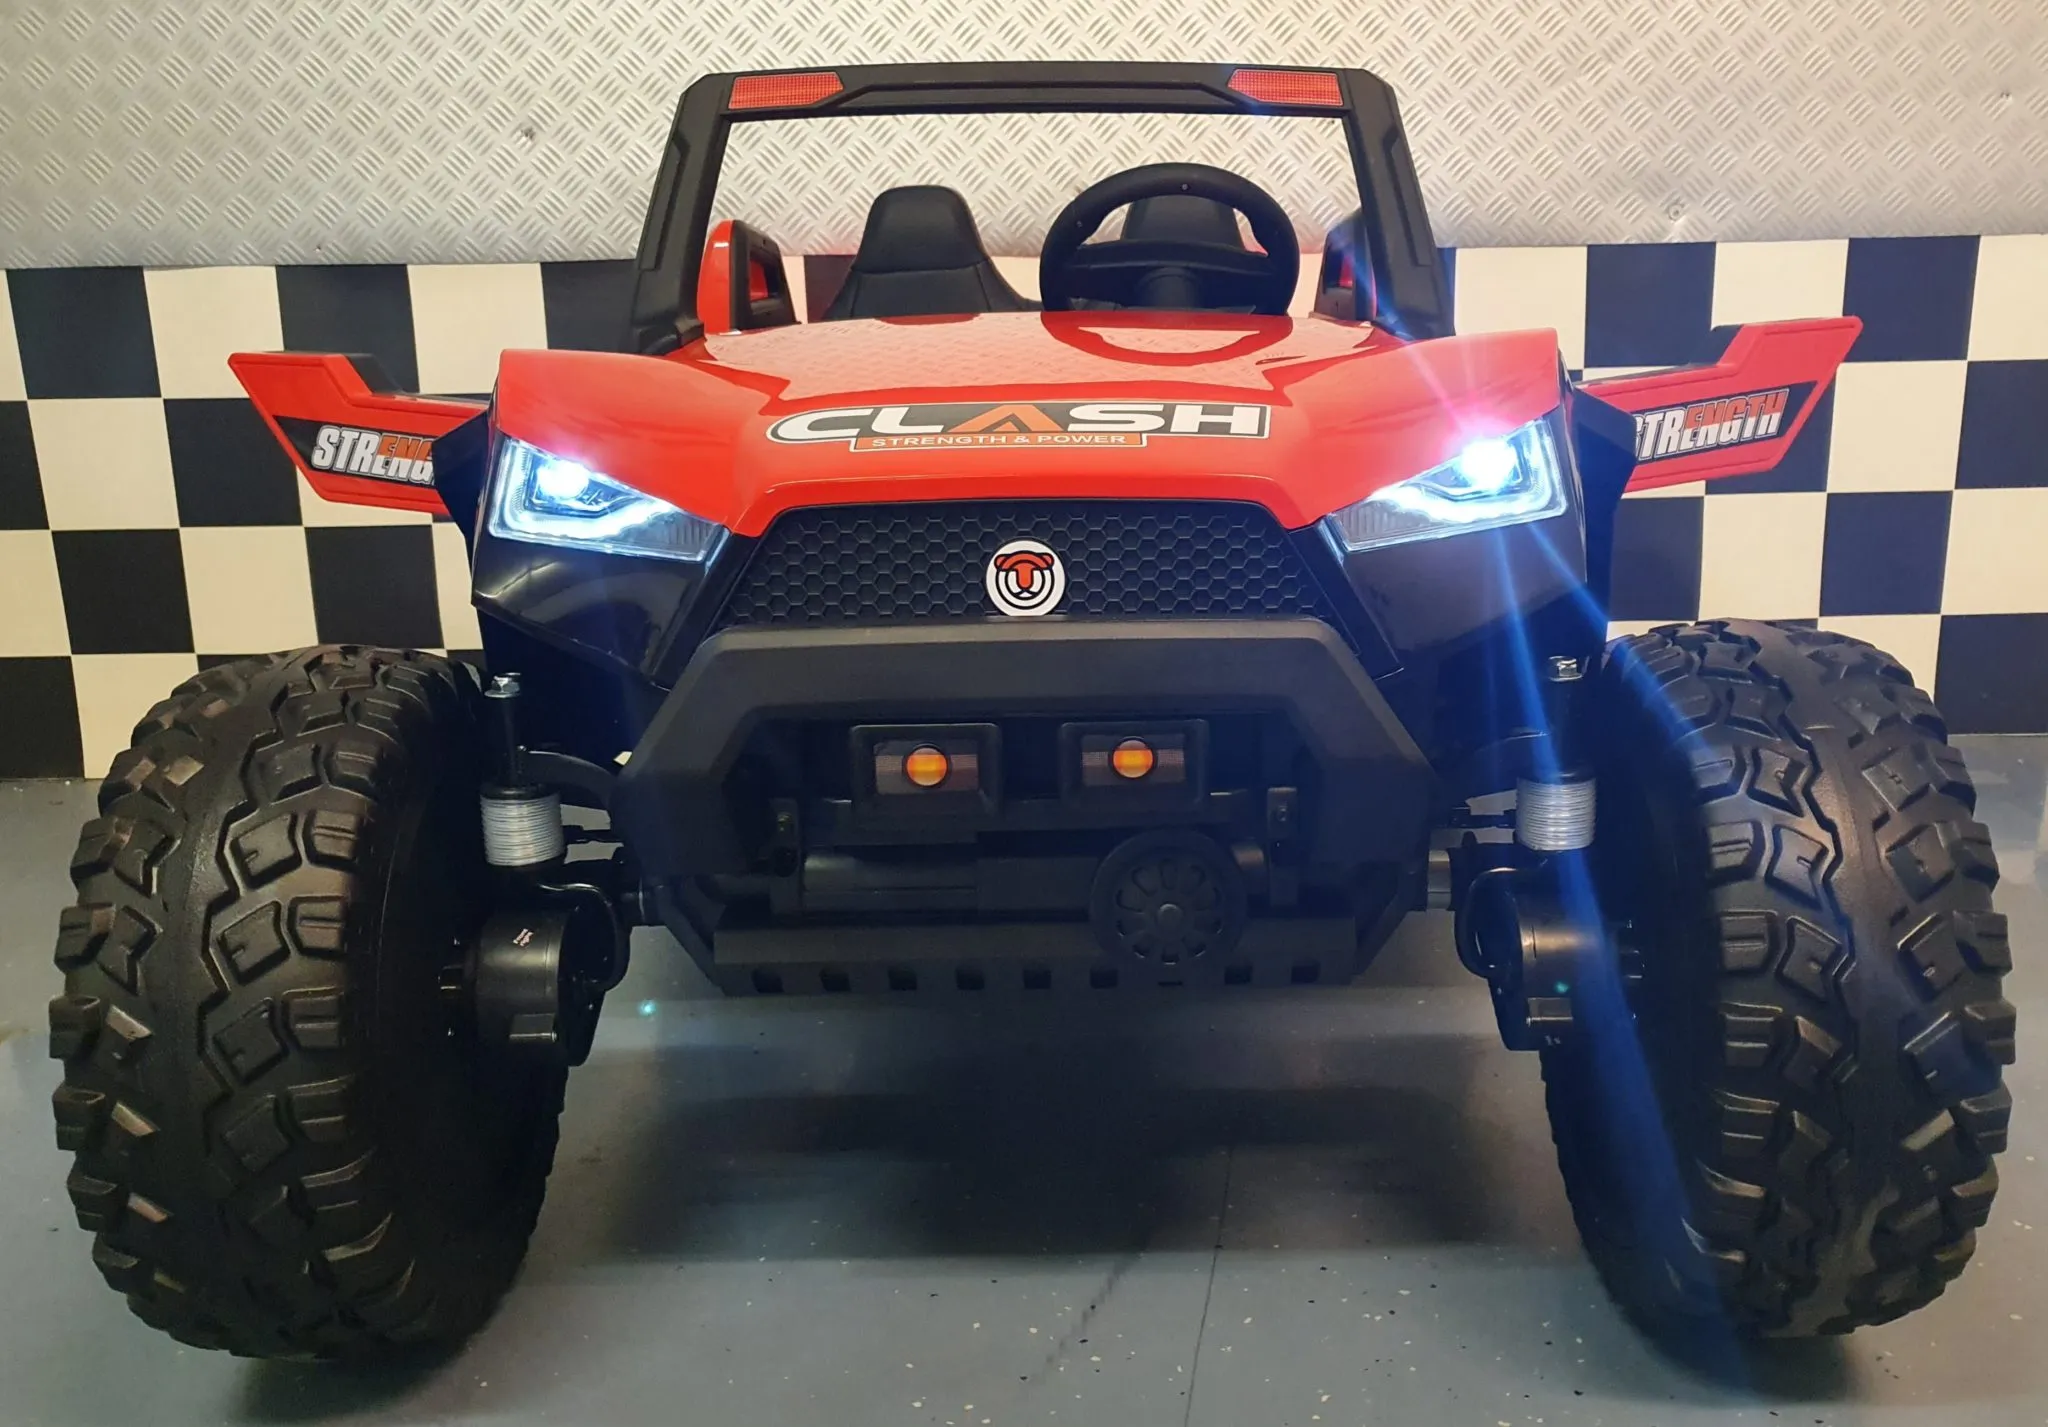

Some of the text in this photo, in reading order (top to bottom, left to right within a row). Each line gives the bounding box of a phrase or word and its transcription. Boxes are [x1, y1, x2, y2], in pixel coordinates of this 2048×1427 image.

[775, 403, 1262, 440] CLASH
[872, 434, 1126, 448] STRENGTH & POWER
